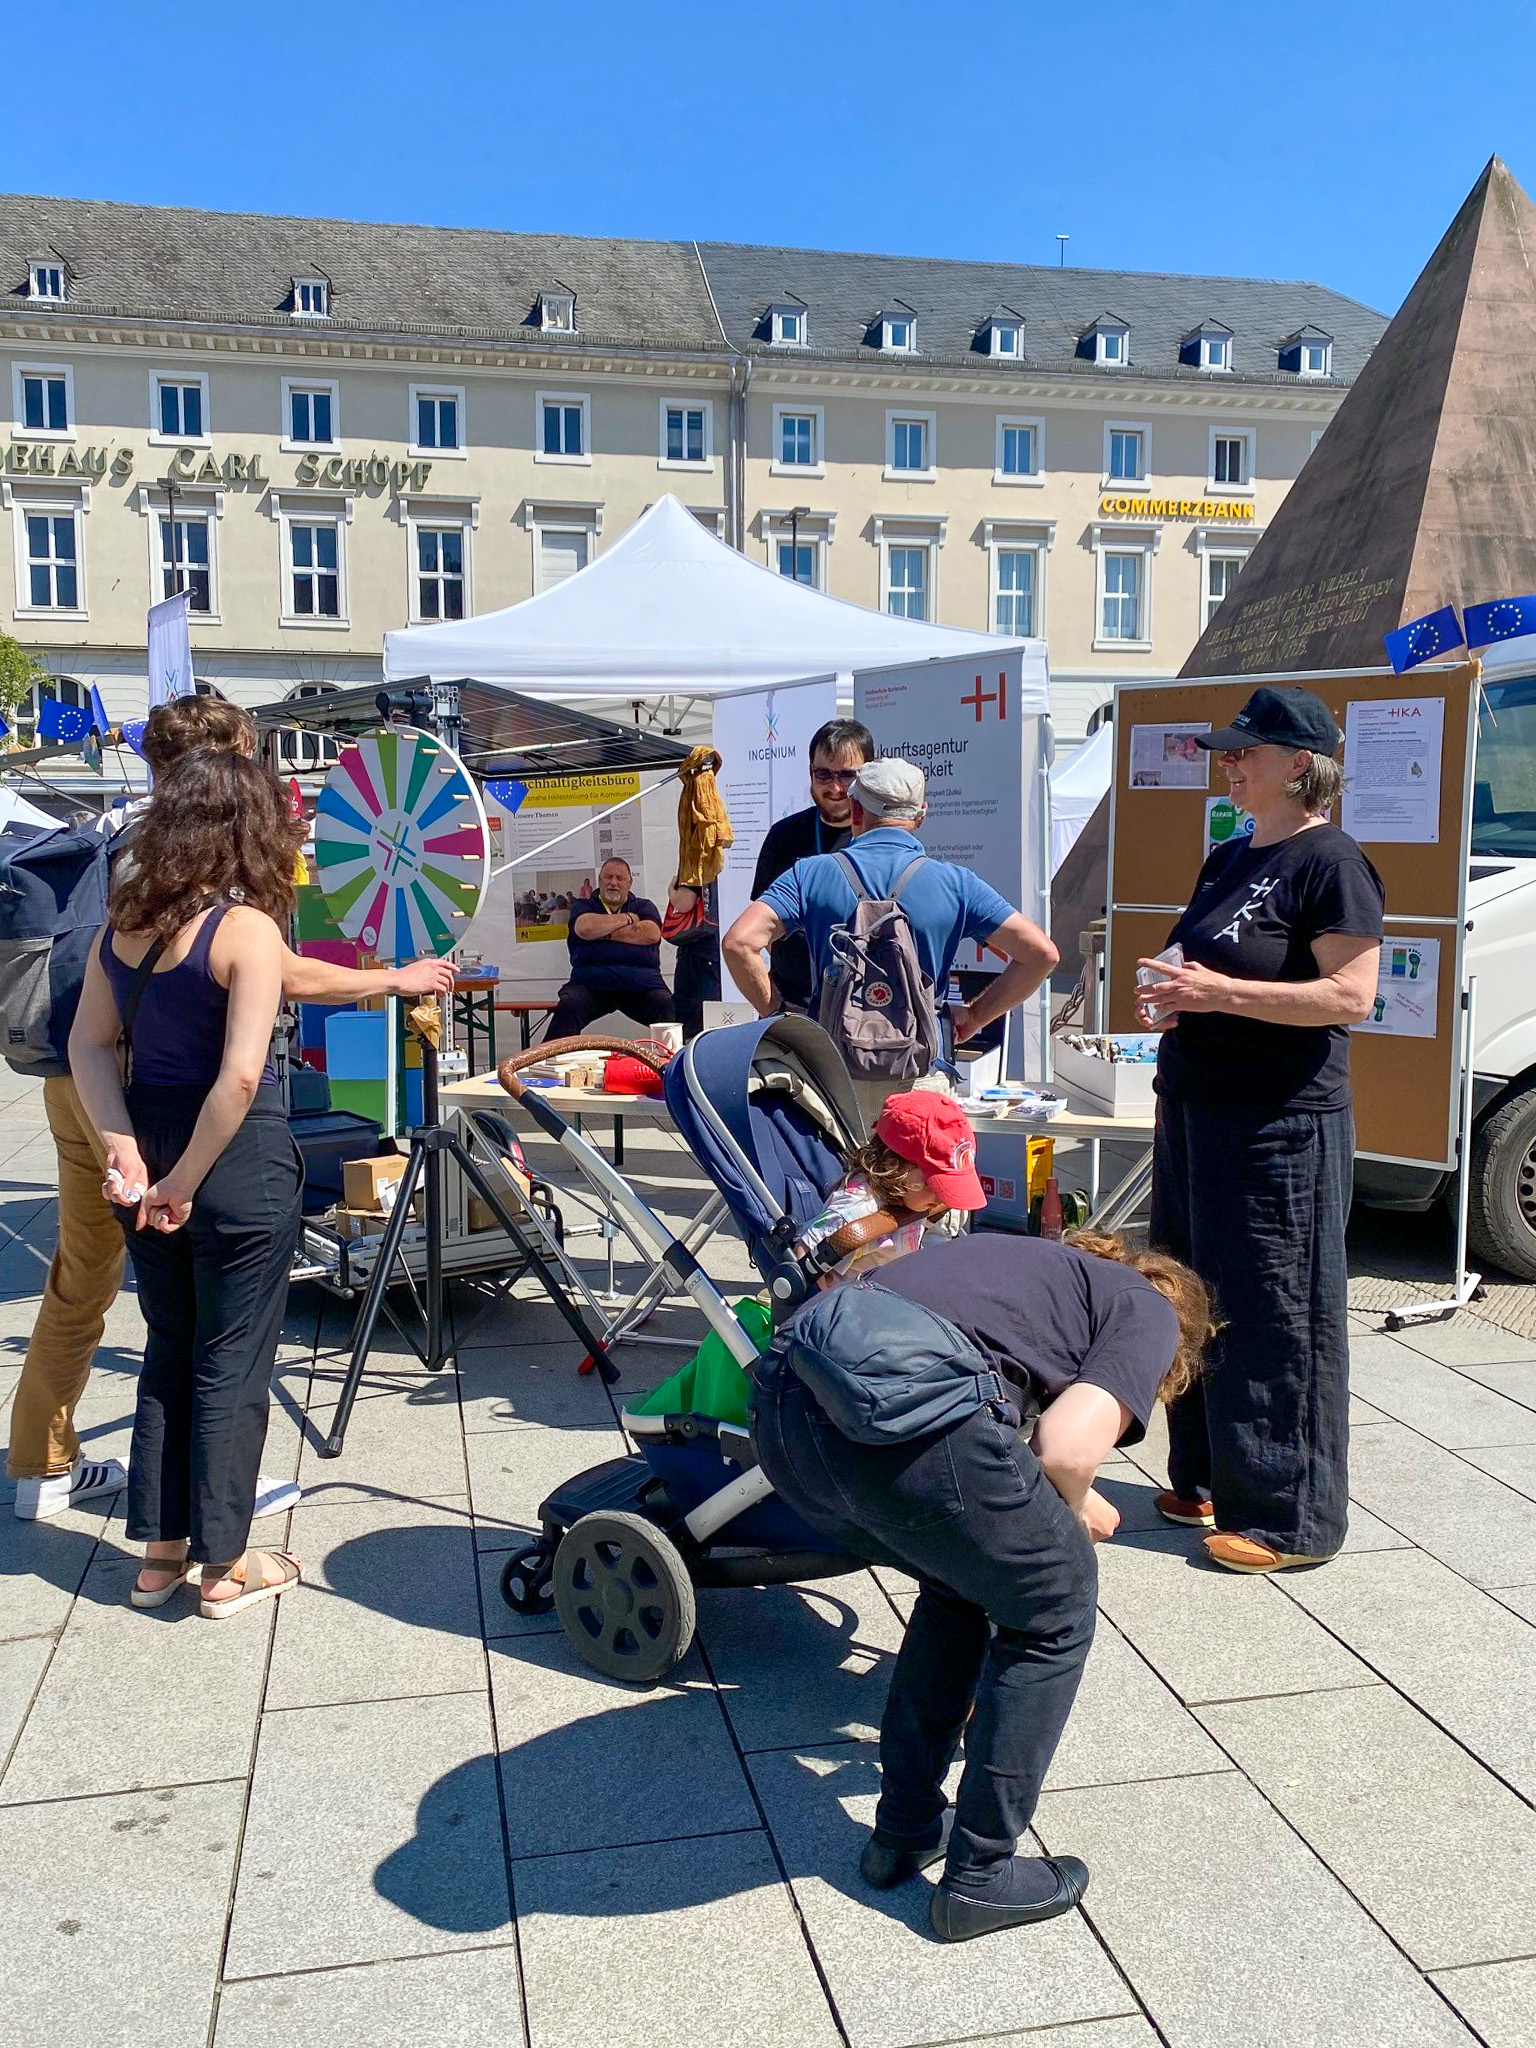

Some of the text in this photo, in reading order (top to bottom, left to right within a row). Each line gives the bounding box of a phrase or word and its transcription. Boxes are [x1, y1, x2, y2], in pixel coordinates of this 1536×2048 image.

[0, 444, 433, 488] EHAUS CARL SCHÖPF
[1102, 497, 1255, 518] COMMERZBANK
[748, 745, 796, 761] INGENIUM
